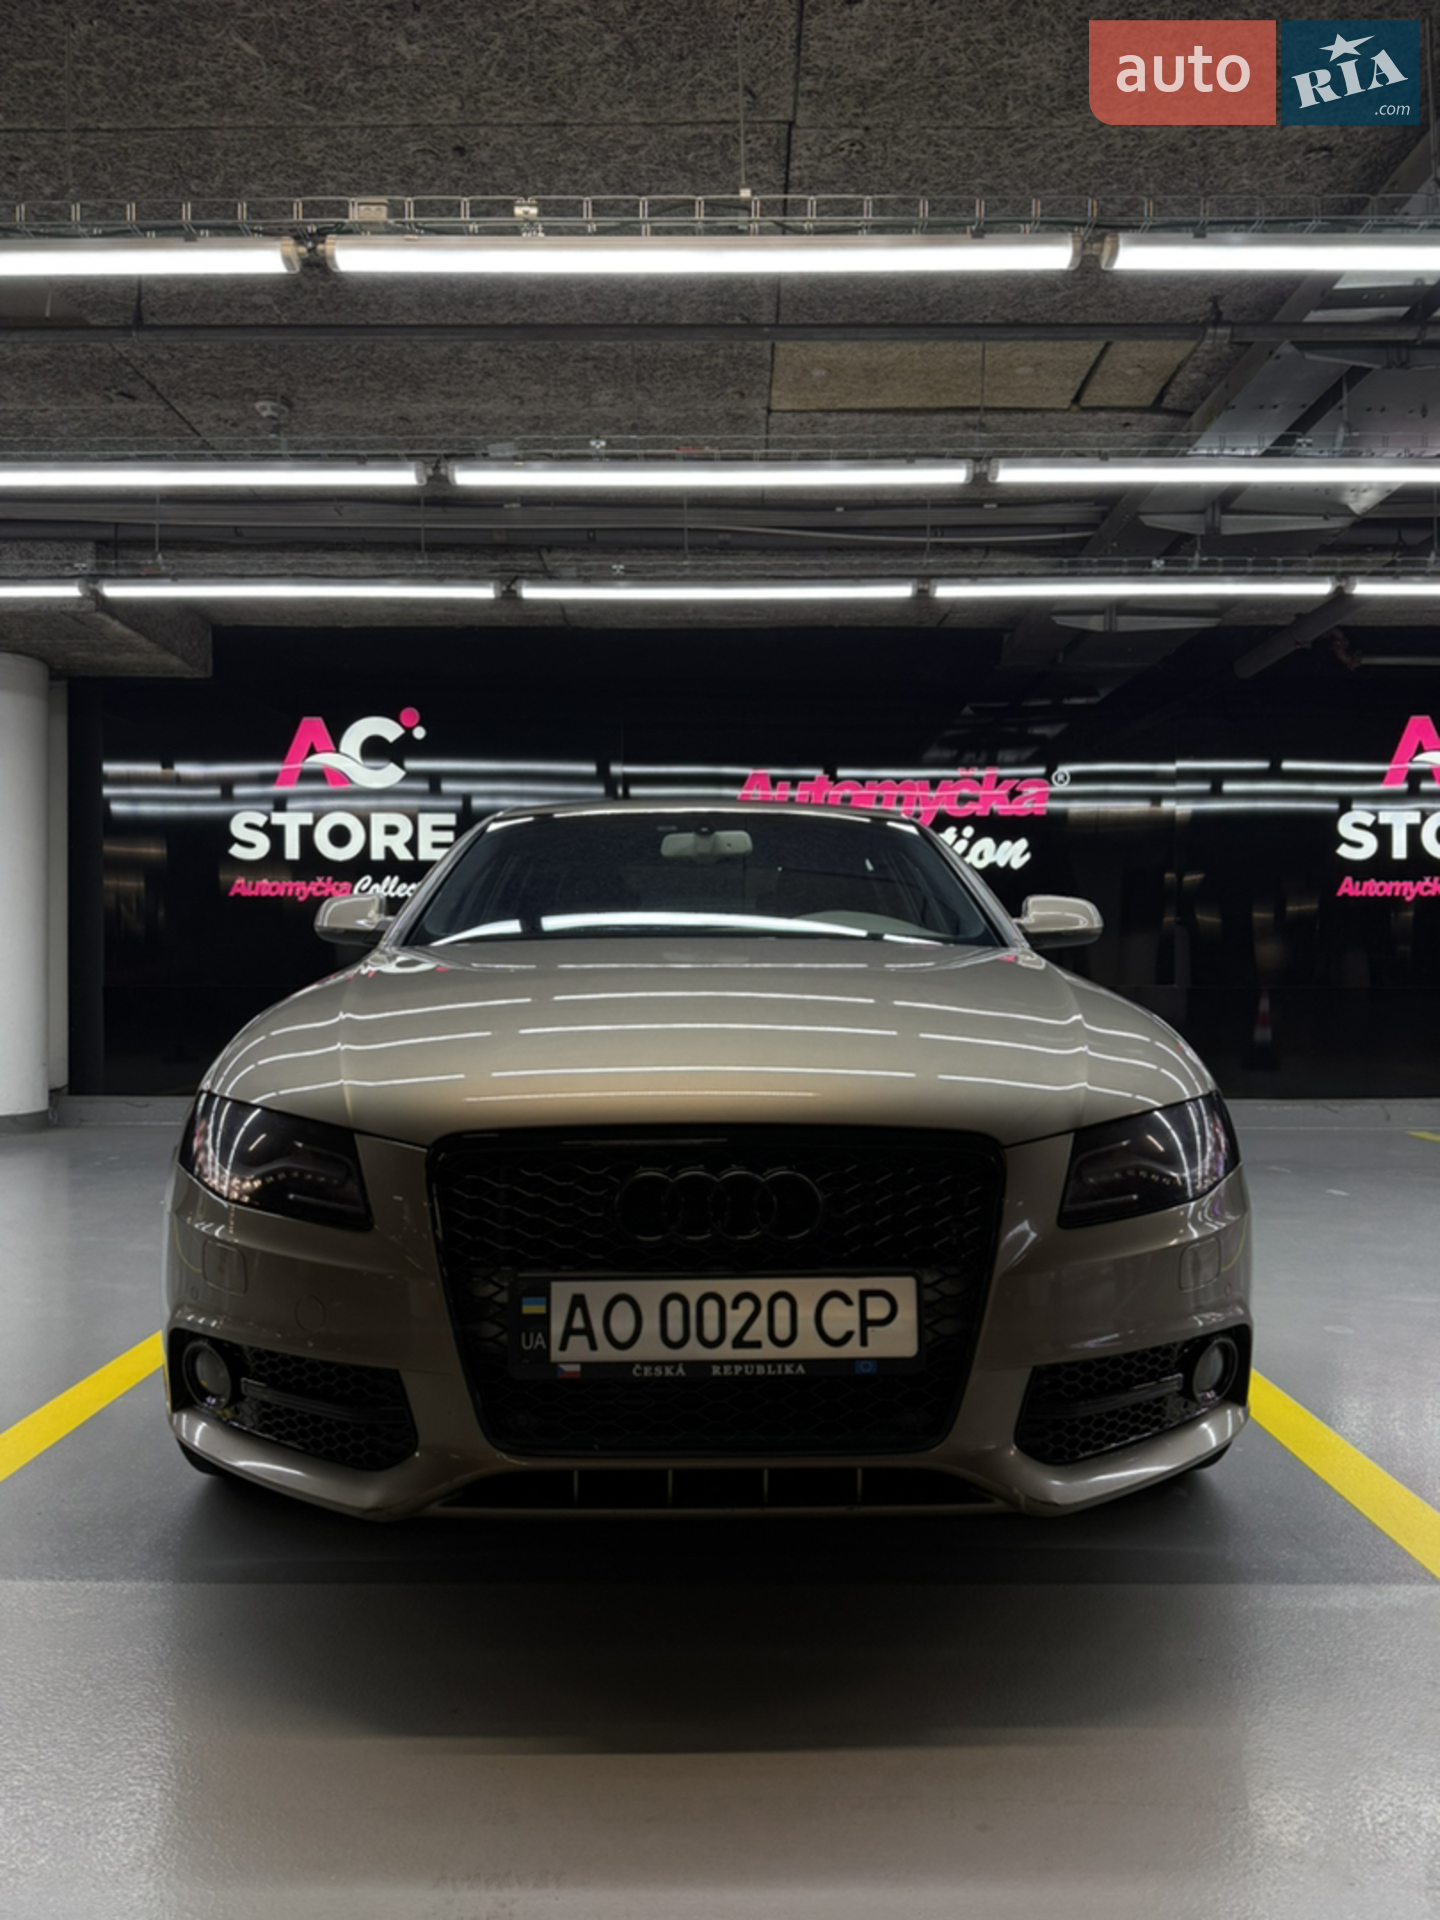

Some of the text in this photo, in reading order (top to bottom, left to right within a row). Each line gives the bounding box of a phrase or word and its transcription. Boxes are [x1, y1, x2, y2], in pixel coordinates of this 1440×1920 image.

[274, 716, 407, 790] AC
[228, 811, 457, 862] STORE
[229, 876, 352, 902] Automyčka
[558, 1288, 899, 1352] AO 0020 CP
[521, 1332, 547, 1351] UA
[632, 1363, 806, 1377] ČESKÁ REPUBLIKA
